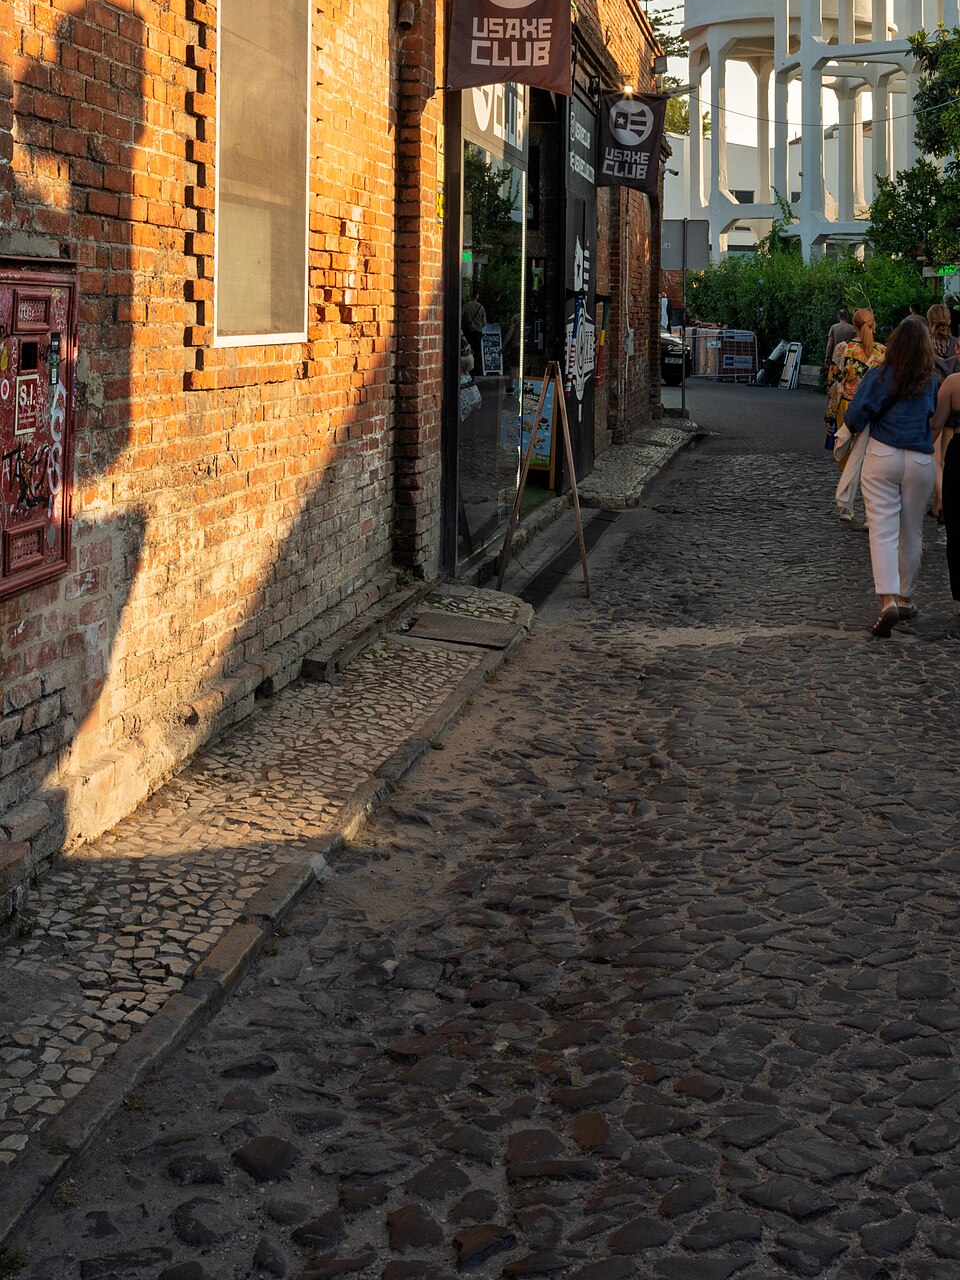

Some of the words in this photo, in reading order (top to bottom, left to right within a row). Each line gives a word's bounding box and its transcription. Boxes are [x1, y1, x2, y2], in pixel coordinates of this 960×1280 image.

[471, 17, 553, 38] USAXE
[470, 40, 550, 67] CLUB
[604, 146, 650, 163] USAXE
[602, 160, 649, 180] CLUB
[19, 383, 36, 407] S.I.
